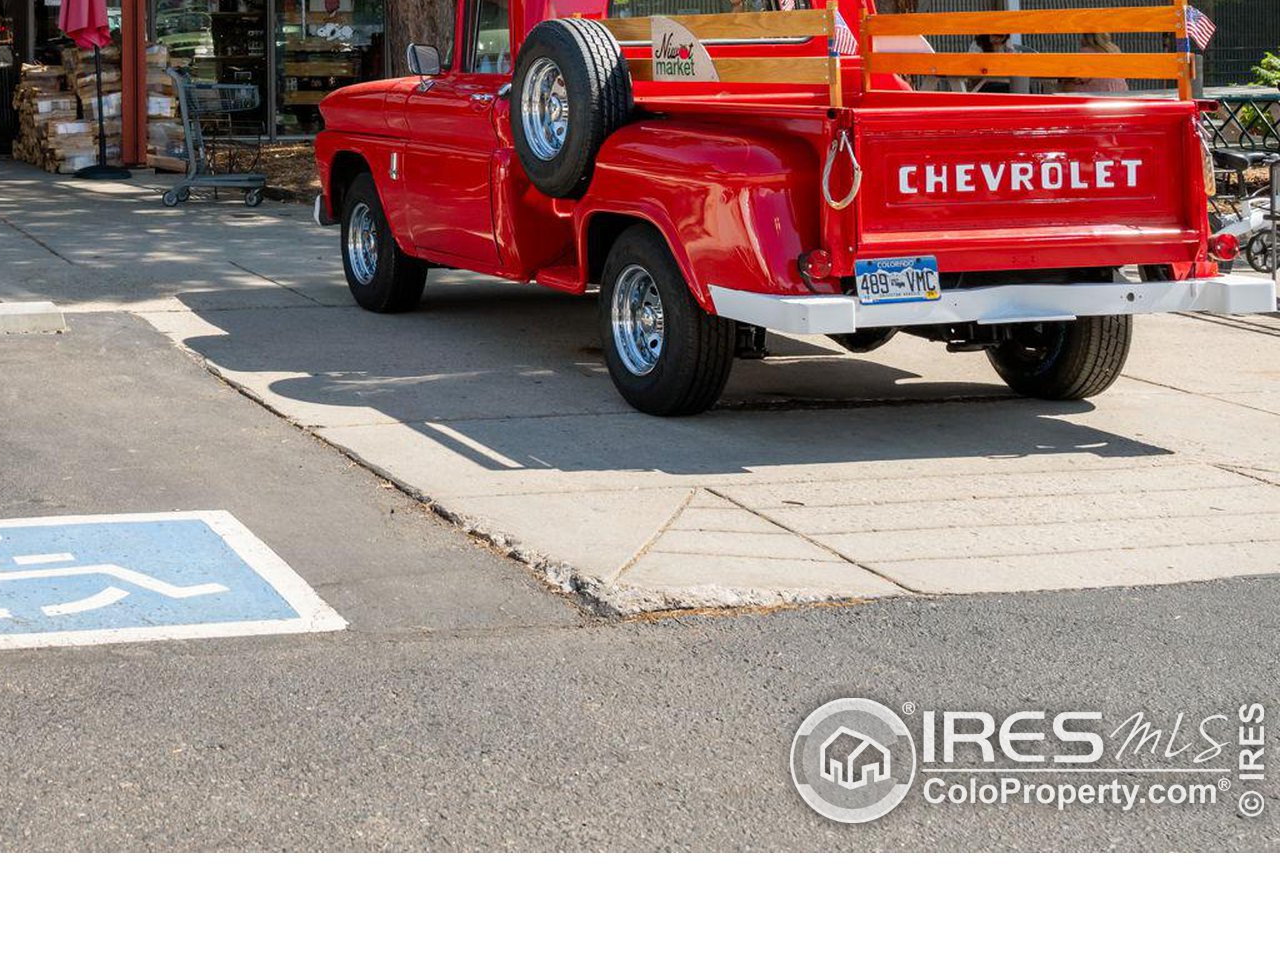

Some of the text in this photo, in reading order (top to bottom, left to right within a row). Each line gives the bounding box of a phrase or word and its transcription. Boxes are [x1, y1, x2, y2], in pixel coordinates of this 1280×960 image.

[656, 57, 695, 76] market
[898, 159, 1142, 194] CHEVROLET
[861, 270, 936, 295] 489 VMC
